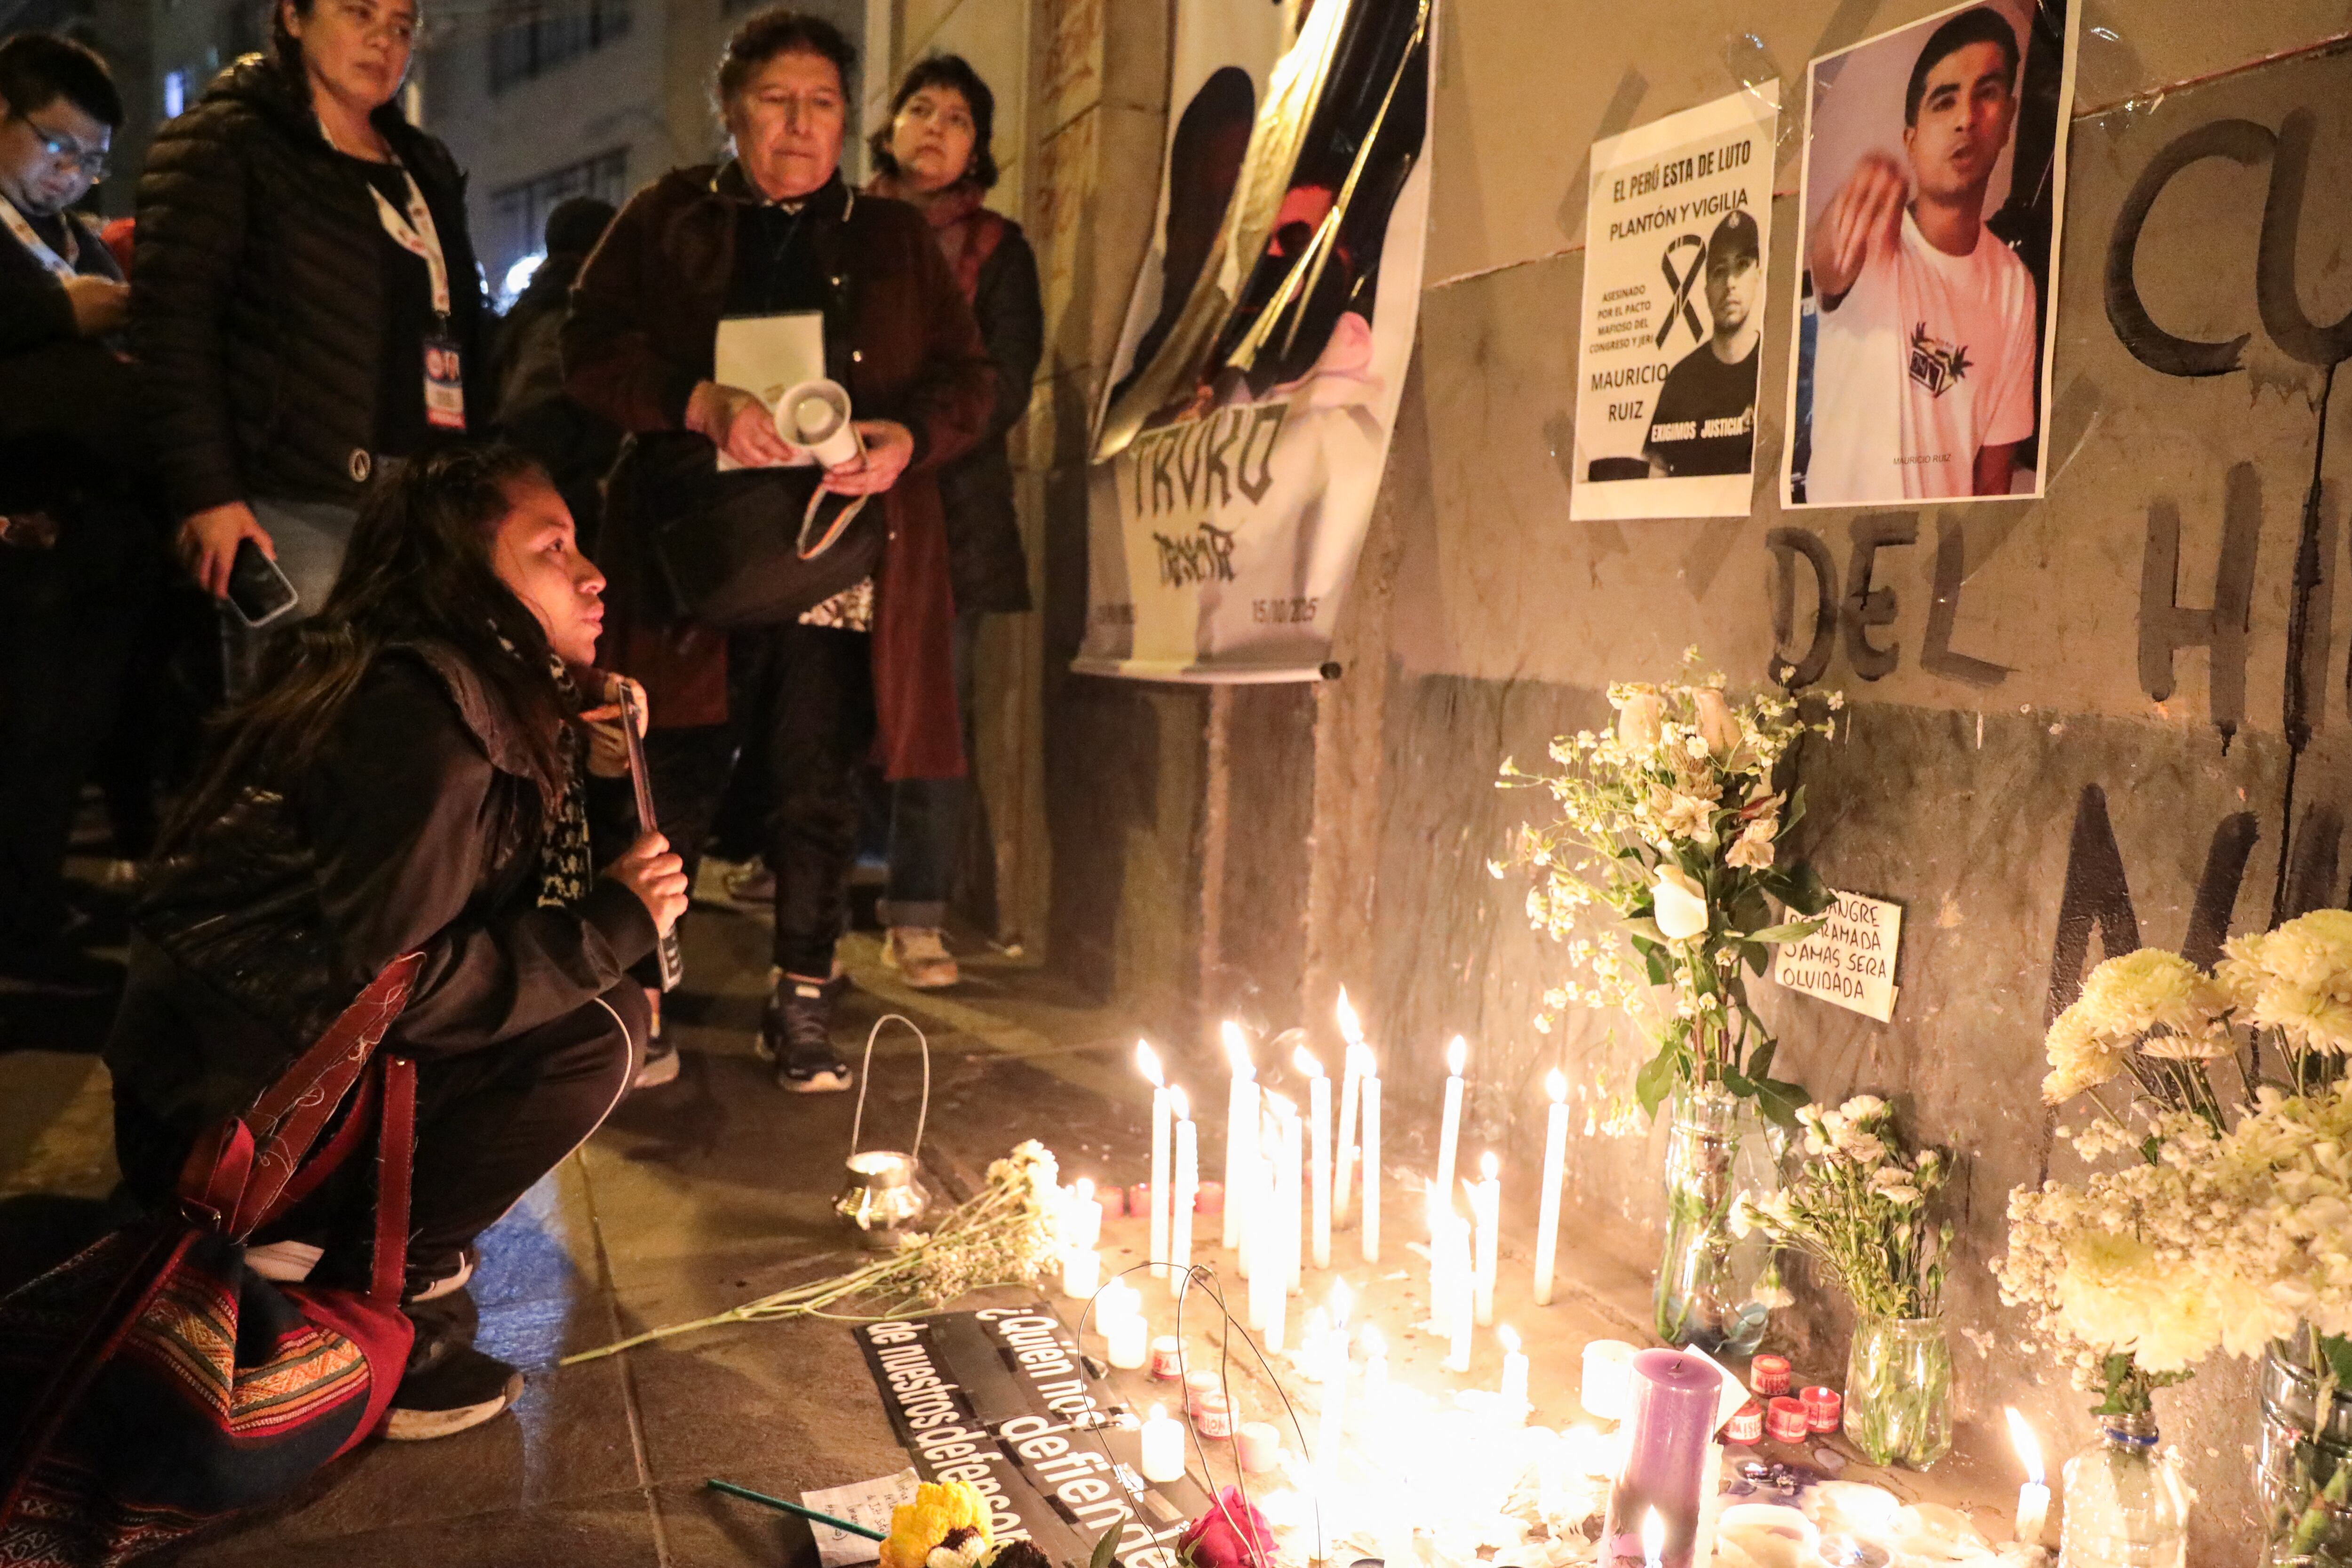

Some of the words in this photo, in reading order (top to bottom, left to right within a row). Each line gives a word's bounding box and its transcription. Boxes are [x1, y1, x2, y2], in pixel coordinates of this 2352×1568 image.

[1613, 180, 1626, 204] EL
[1629, 163, 1660, 199] PERÚ
[1663, 158, 1693, 190] ESTA
[1698, 151, 1715, 178] DE
[1718, 140, 1751, 173] LUTO
[1609, 204, 1677, 241] PLANTÓN
[1678, 204, 1690, 223] Y
[1692, 188, 1748, 219] VIGILIA
[1602, 284, 1646, 302] ASESINADO
[1597, 307, 1613, 321] POR
[1615, 305, 1623, 317] EL
[1624, 301, 1652, 315] PACTO
[1597, 321, 1633, 336] MAFIOSO
[1634, 318, 1649, 332] DEL
[1589, 338, 1631, 355] CONGRESO
[1591, 362, 1669, 391] MAURICIO
[1608, 401, 1644, 422] RUIZ
[1651, 421, 1696, 443] EXIGIMOS
[1700, 416, 1743, 438] JUSTICIA
[1893, 455, 1931, 466] MAURICIO
[1932, 454, 1951, 463] RUIZ
[1765, 510, 2018, 690] DEL
[1823, 899, 1879, 927] ANGRE
[1784, 943, 1841, 968] JAMAS
[1846, 953, 1887, 979] SERA
[1783, 968, 1865, 1000] OLVIDADA
[866, 1321, 929, 1345] de
[976, 1308, 1081, 1378] ¿Quién
[1037, 1378, 1106, 1428] nos
[878, 1344, 960, 1429] nuestros
